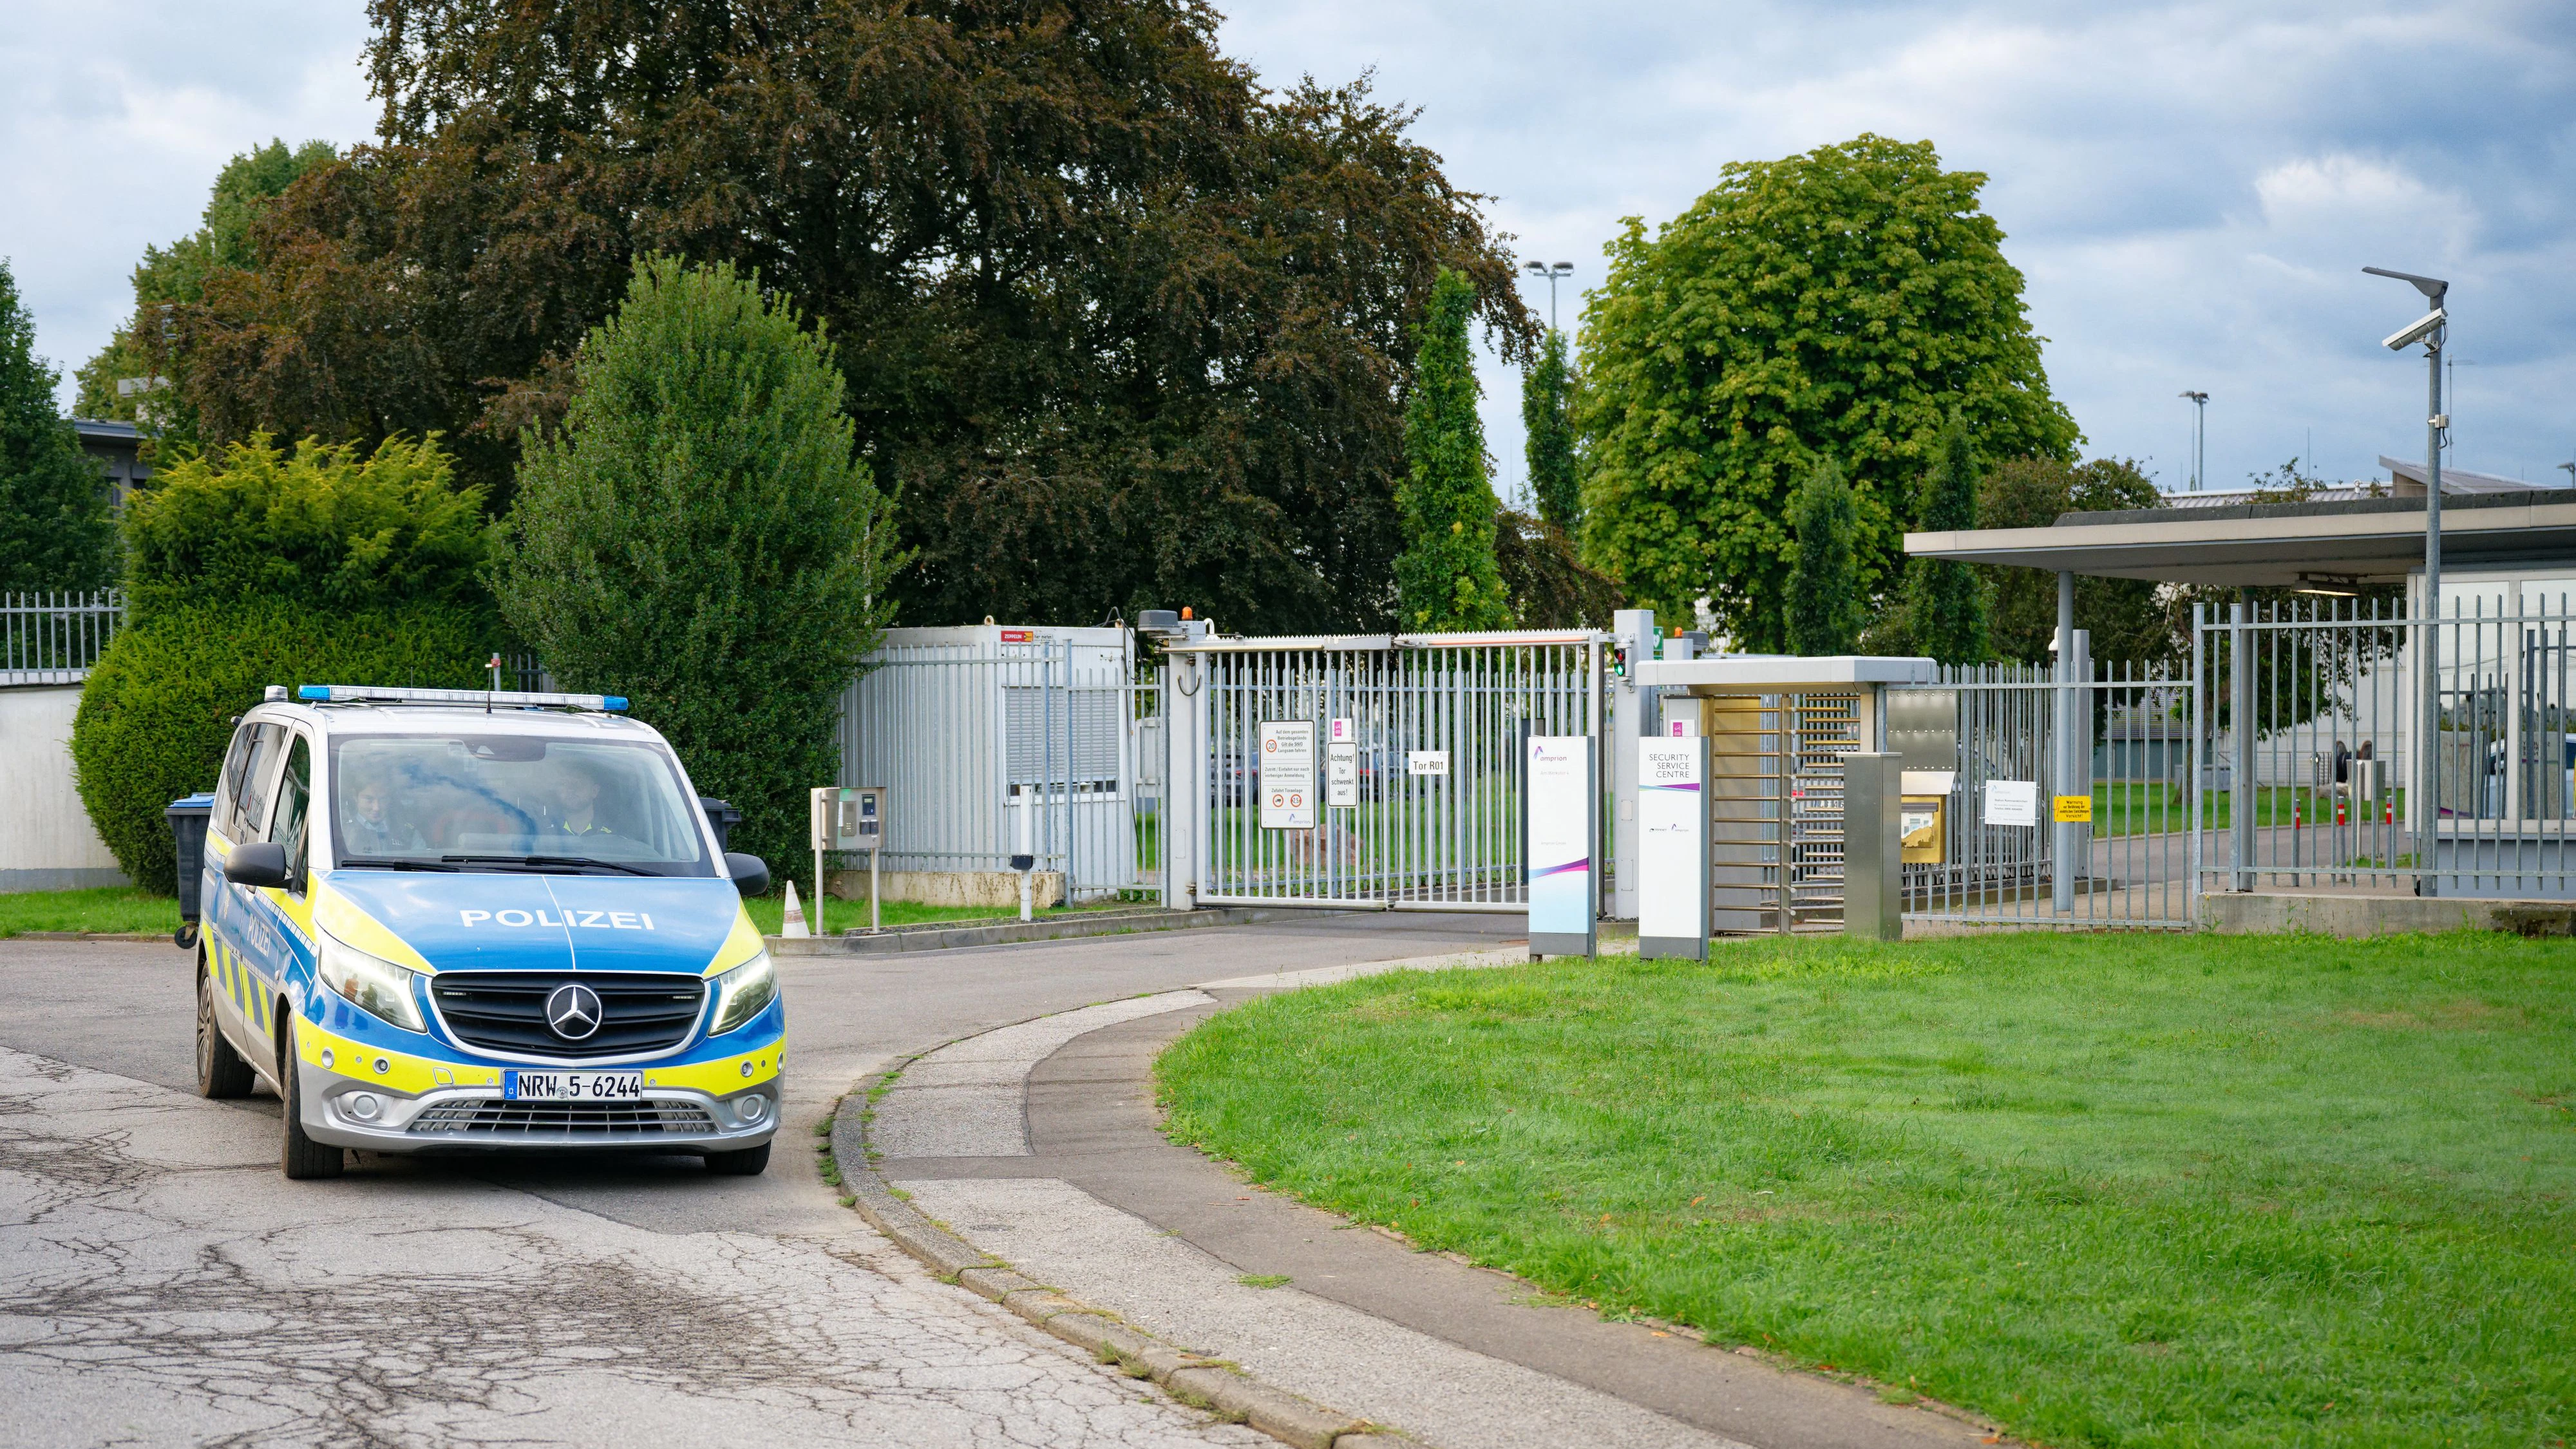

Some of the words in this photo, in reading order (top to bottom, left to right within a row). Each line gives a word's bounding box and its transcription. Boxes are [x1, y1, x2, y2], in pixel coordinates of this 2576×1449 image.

[1330, 754, 1355, 763] Achtung!
[1413, 761, 1427, 770] Tor
[1429, 761, 1443, 770] R01
[460, 909, 655, 931] POLIZEI
[247, 913, 271, 958] POLIZEI
[518, 1075, 557, 1097] NRW
[569, 1076, 640, 1097] 5-6244
